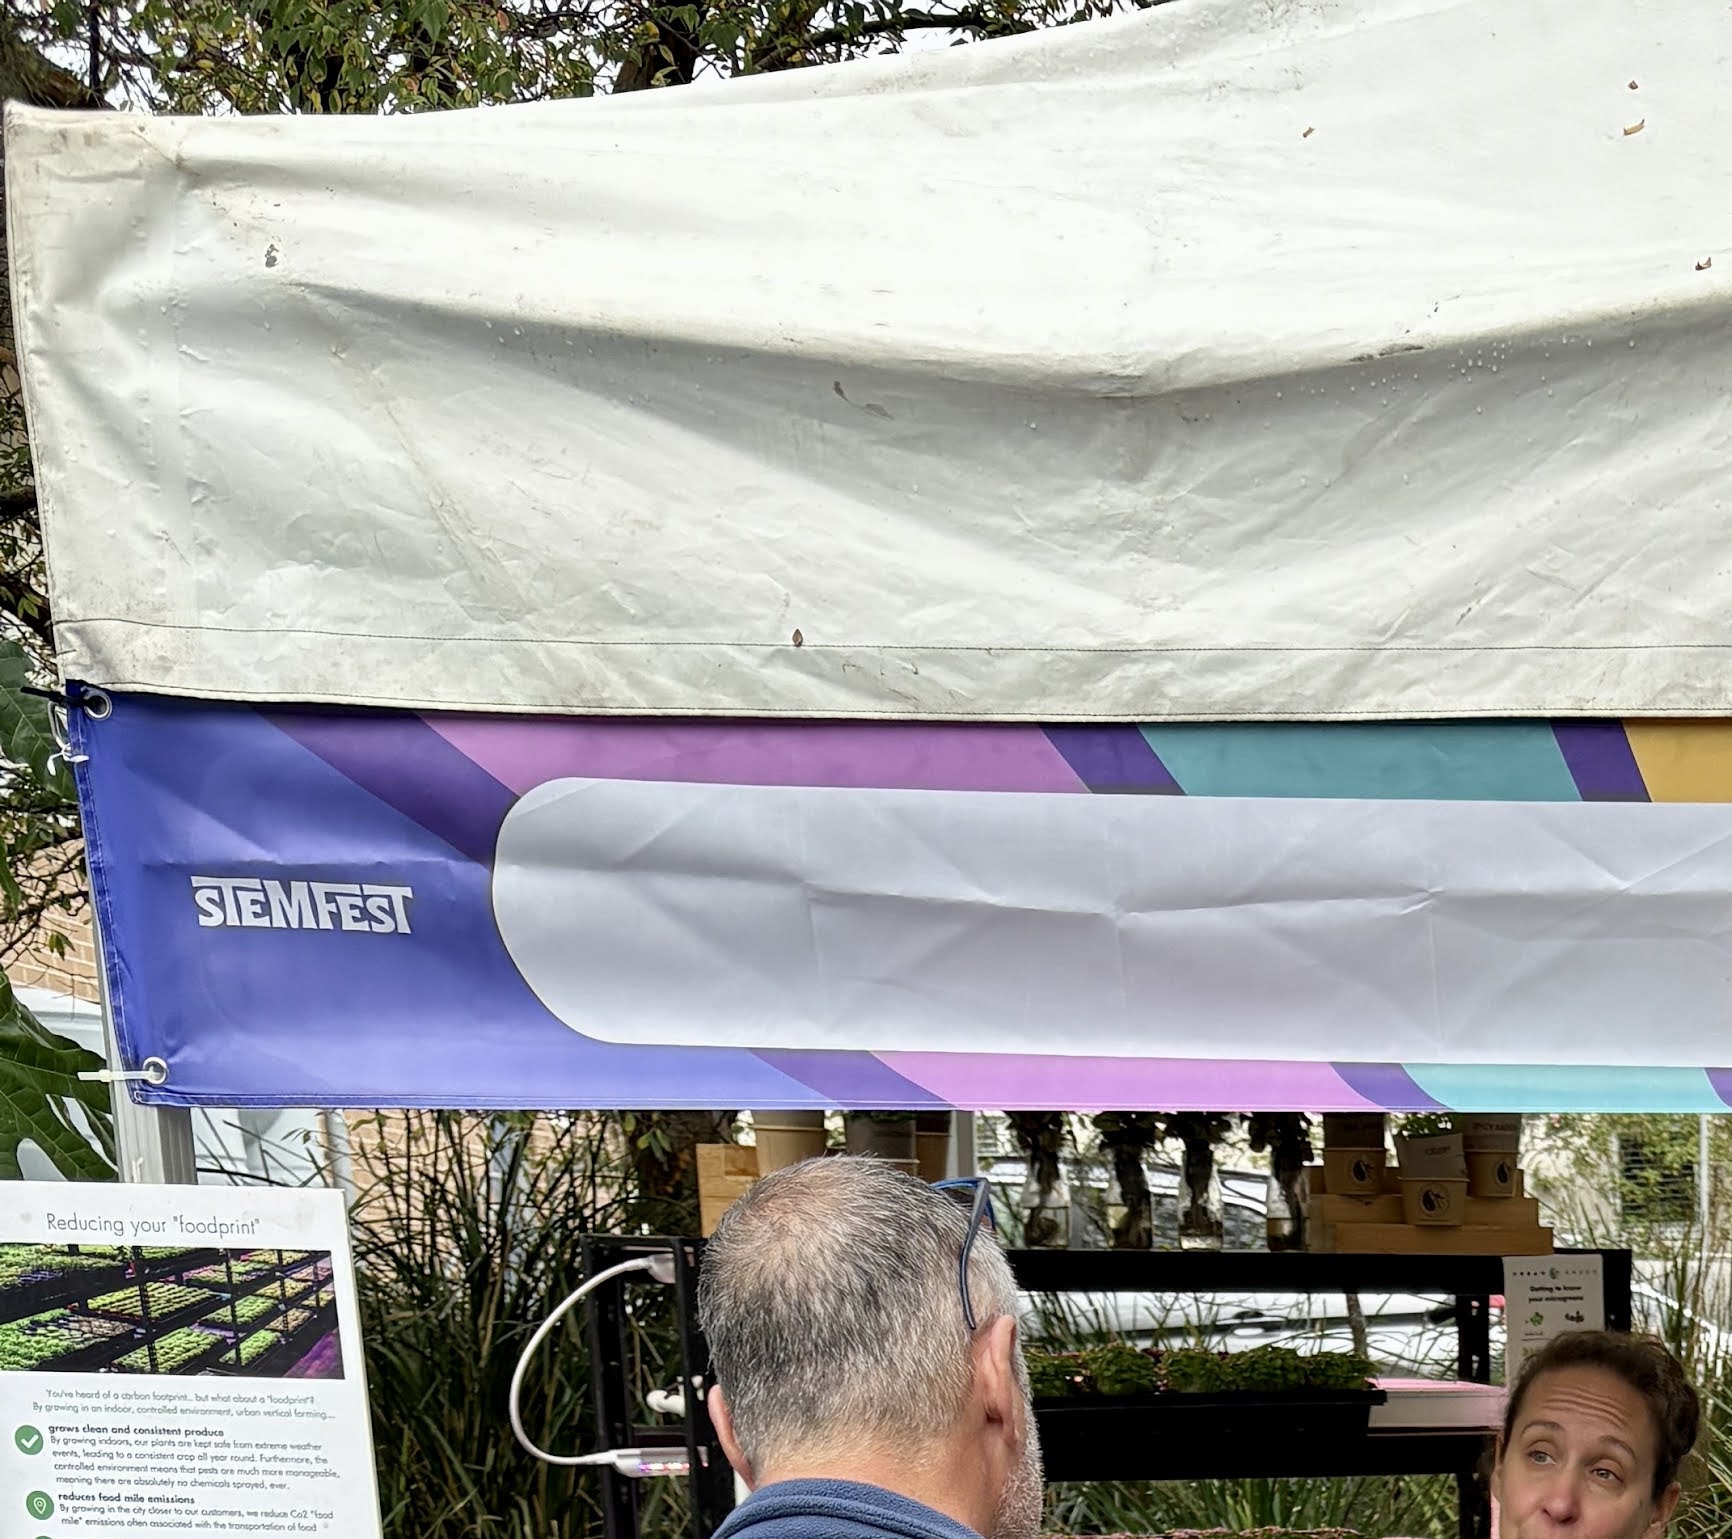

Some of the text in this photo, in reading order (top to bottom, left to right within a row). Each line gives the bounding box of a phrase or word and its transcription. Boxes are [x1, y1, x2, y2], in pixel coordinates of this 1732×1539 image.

[190, 876, 413, 934] STEMFEST
[46, 1211, 259, 1239] Reducing your "foodprint"
[48, 1424, 224, 1437] grows clean and consistent produce
[58, 1491, 195, 1504] reduces food mile emissions
